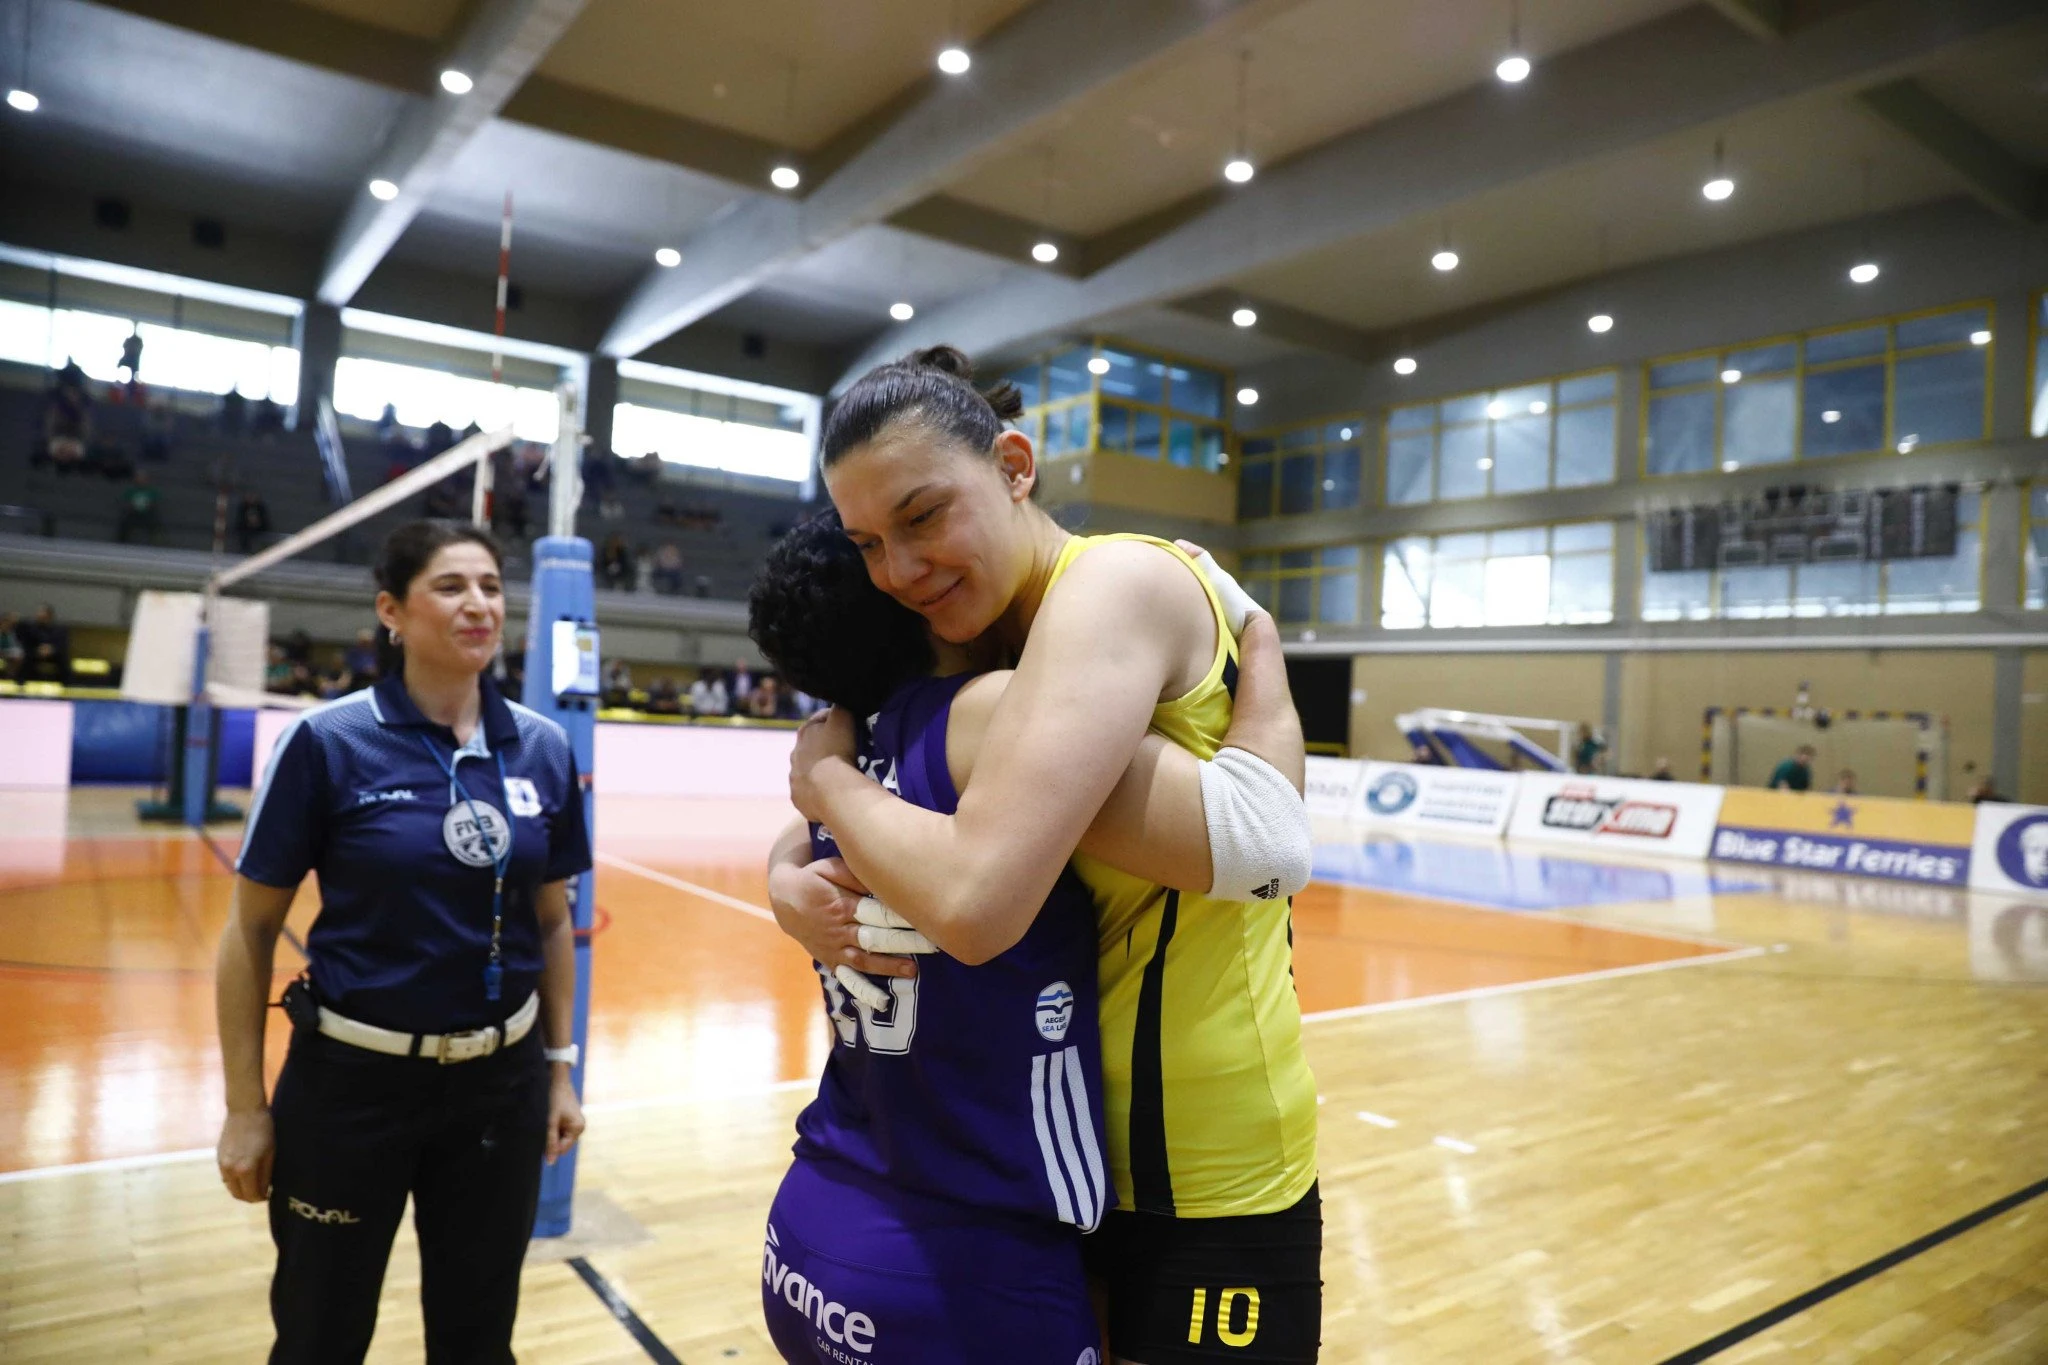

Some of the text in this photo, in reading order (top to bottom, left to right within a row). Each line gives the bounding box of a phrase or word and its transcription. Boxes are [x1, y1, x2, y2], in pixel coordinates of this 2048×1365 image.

[1715, 830, 1956, 880] Blue Star Ferries
[763, 1244, 876, 1353] avance
[1188, 1287, 1260, 1347] 10
[816, 1336, 873, 1365] CAR RENT
